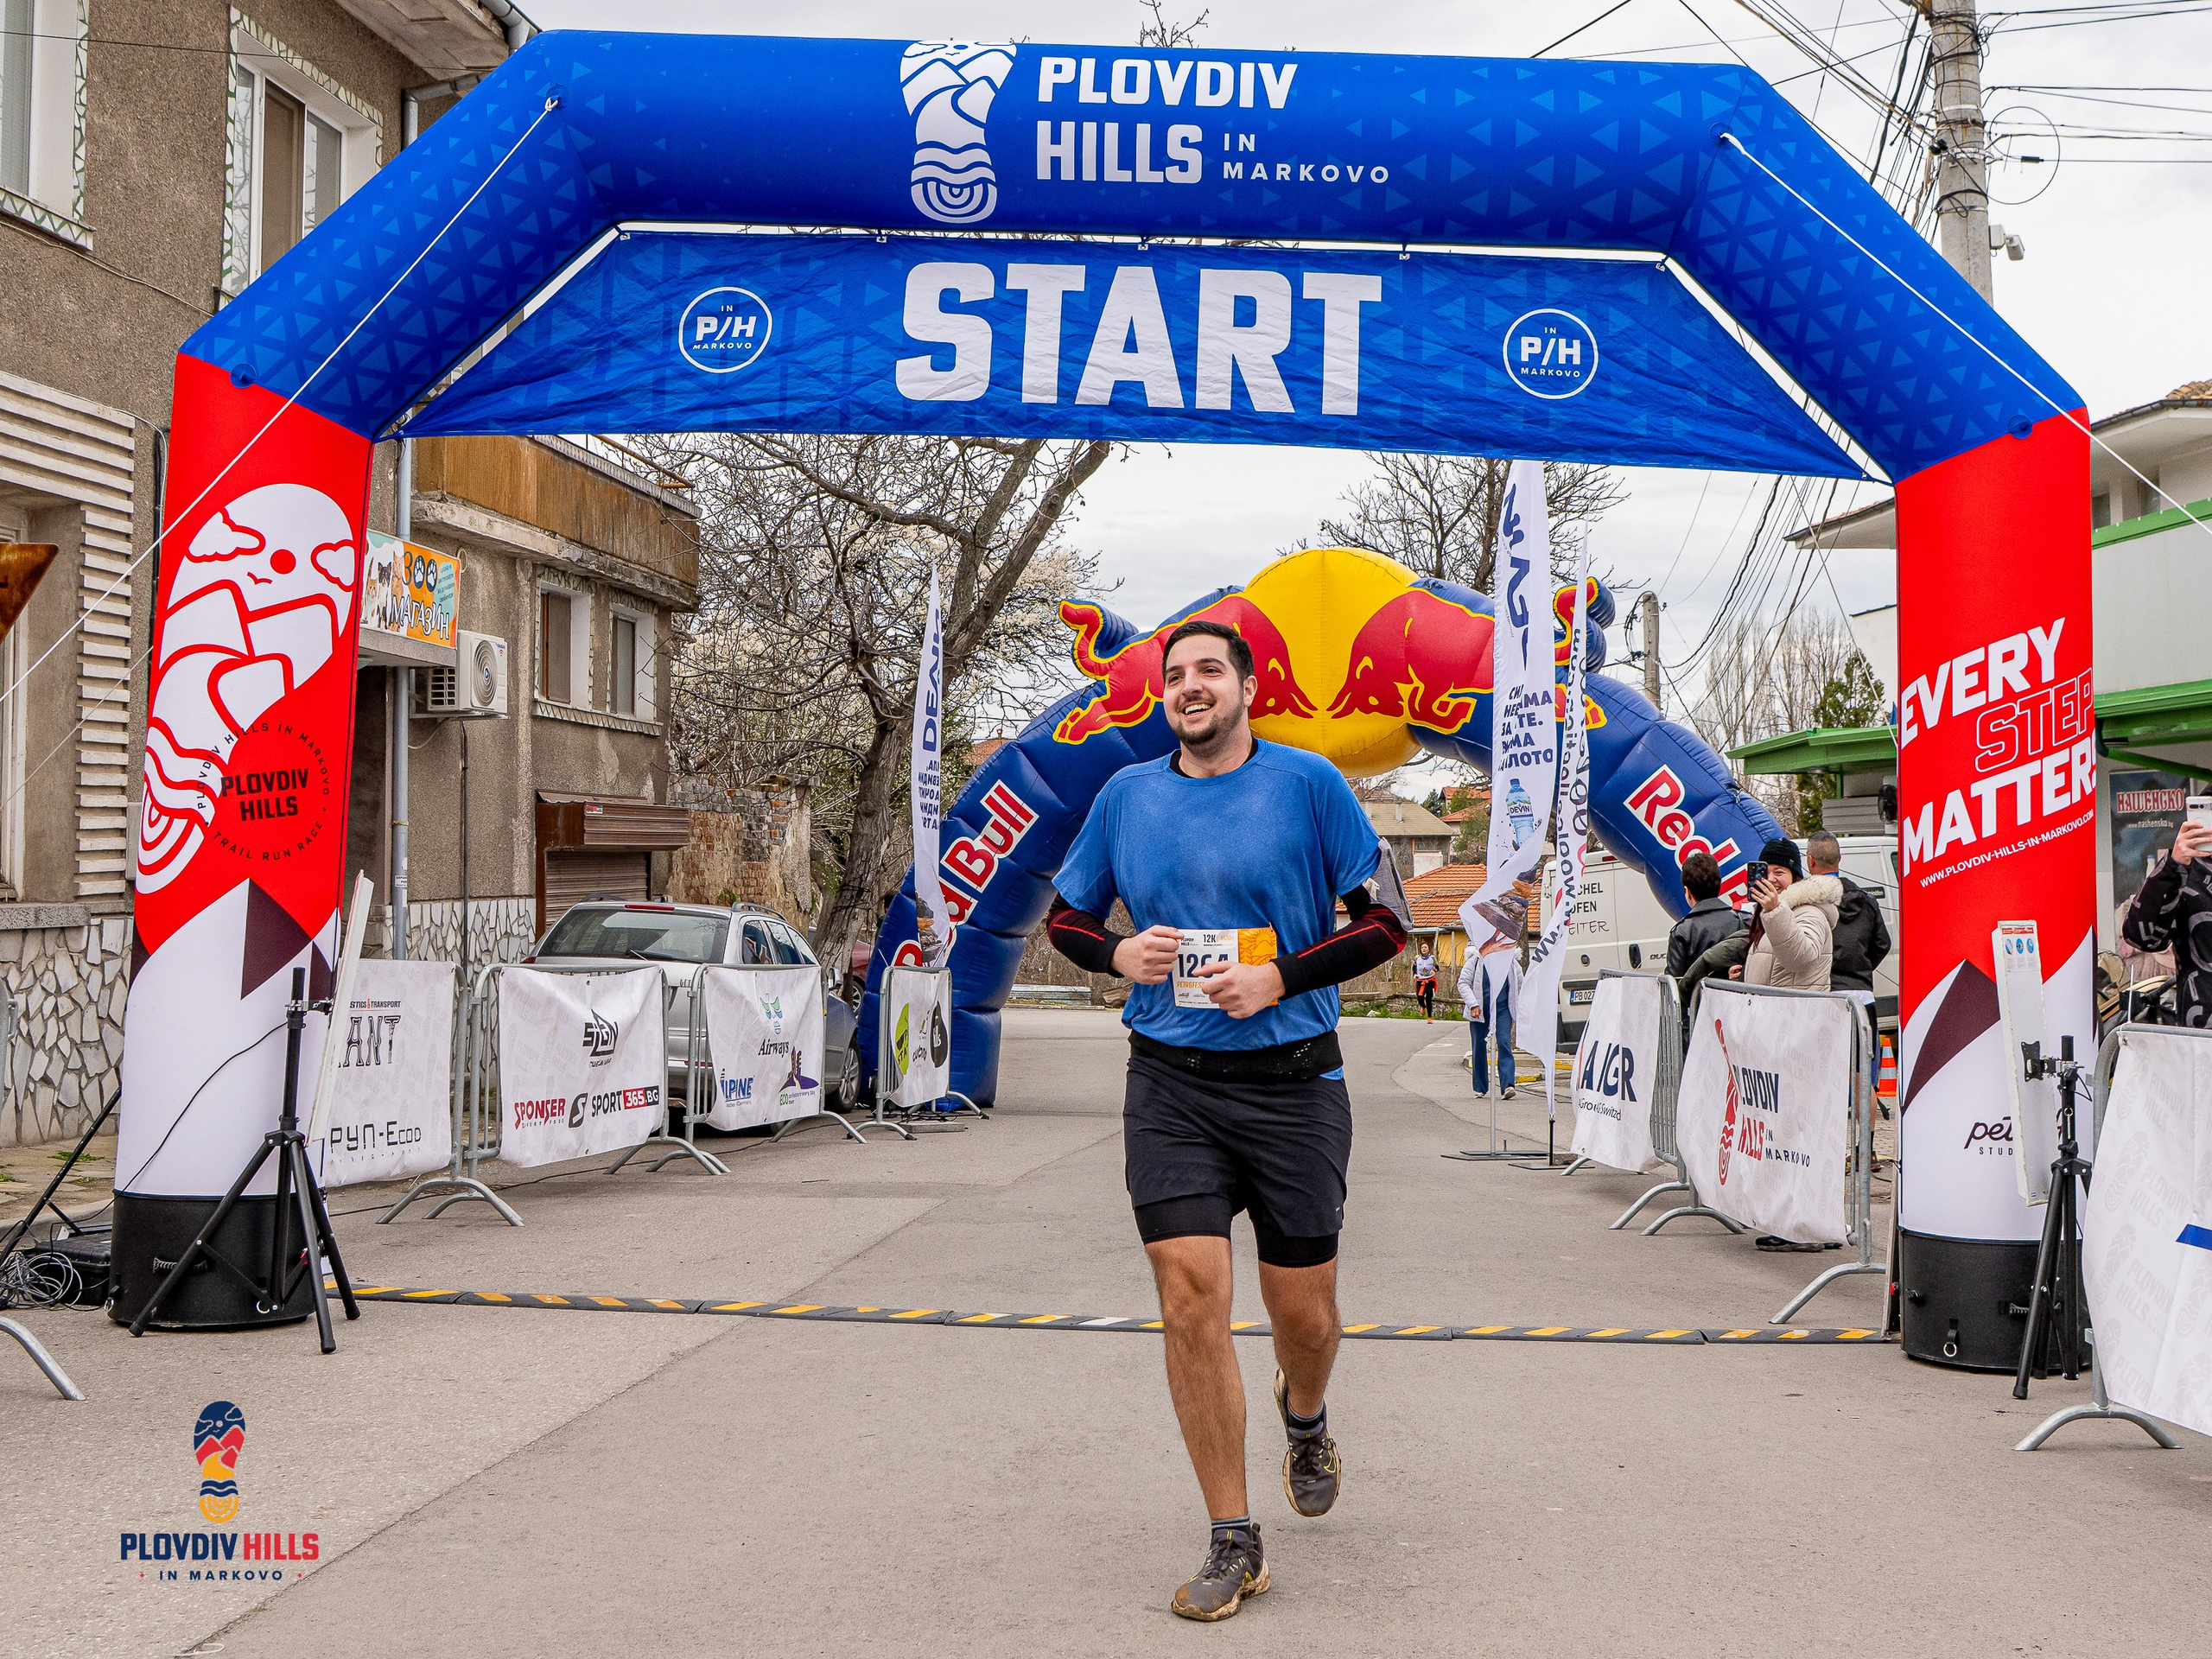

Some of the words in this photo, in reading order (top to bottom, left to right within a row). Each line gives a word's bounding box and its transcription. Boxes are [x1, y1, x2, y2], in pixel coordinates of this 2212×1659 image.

[1038, 56, 1298, 109] PLOVDIV
[1037, 120, 1203, 183] HILLS
[1224, 133, 1256, 152] IN
[1223, 161, 1389, 183] MARKOVO
[696, 316, 757, 341] P/H
[895, 262, 1382, 416] START
[1521, 336, 1581, 366] P/H
[1521, 367, 1580, 378] MARKOVO
[391, 594, 450, 640] МАГАЗИН
[1901, 617, 2066, 750] EVERY
[1975, 667, 2094, 773] STEP
[196, 745, 221, 810] PLOVDIV
[224, 722, 270, 745] HILLS
[278, 723, 293, 734] IN
[299, 733, 330, 796] MARKOVO
[220, 768, 309, 798] PLOVDIV
[239, 796, 299, 822] HILLS
[1510, 804, 1530, 815] DEVIN
[1627, 767, 1738, 868] Red
[213, 830, 252, 860] TRAIL
[262, 849, 291, 861] RUN
[297, 821, 322, 850] RACE
[942, 780, 1039, 892] Bull
[1920, 809, 2094, 888] WWW.PLOVDIV-HILLS-IN-MARKOVO.COM
[1203, 934, 1217, 943] 12K
[1584, 990, 1595, 1001] 027
[342, 1015, 402, 1068] ANT
[758, 1039, 790, 1058] Airways
[514, 1098, 566, 1130] SPONSER
[1765, 1128, 1774, 1141] IN
[1979, 1147, 2013, 1156] STUD
